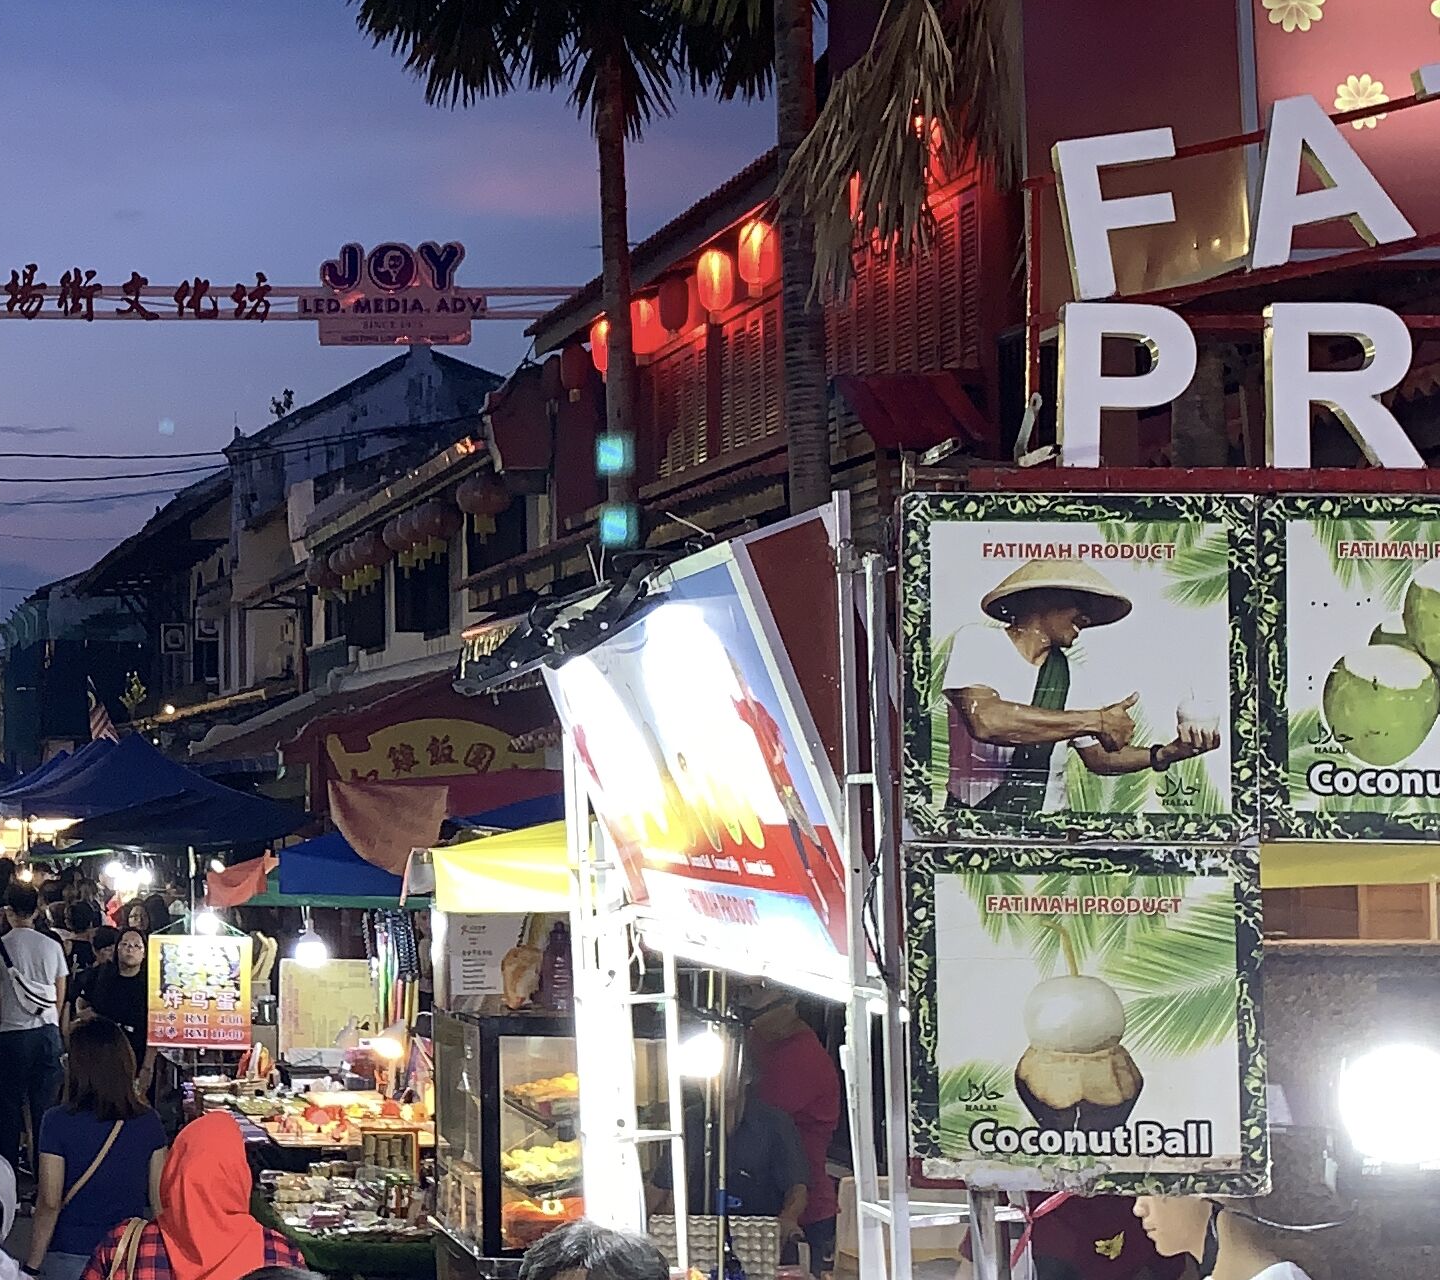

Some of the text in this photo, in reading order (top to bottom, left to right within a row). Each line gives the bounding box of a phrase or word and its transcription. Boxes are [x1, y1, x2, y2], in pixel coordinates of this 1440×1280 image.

[1051, 65, 1440, 301] FA
[320, 241, 466, 292] JOY
[302, 298, 346, 313] LED.
[1062, 301, 1426, 469] PR
[982, 542, 1177, 561] FATIMAH PRODUCT
[1338, 541, 1428, 560] FATIMAH
[987, 895, 1182, 915] FATIMAH PRODUCT
[163, 990, 237, 1011] 炸鸟蛋
[184, 1013, 209, 1024] RM
[184, 1027, 209, 1039] RM
[971, 1120, 1213, 1157] Coconut Ball
